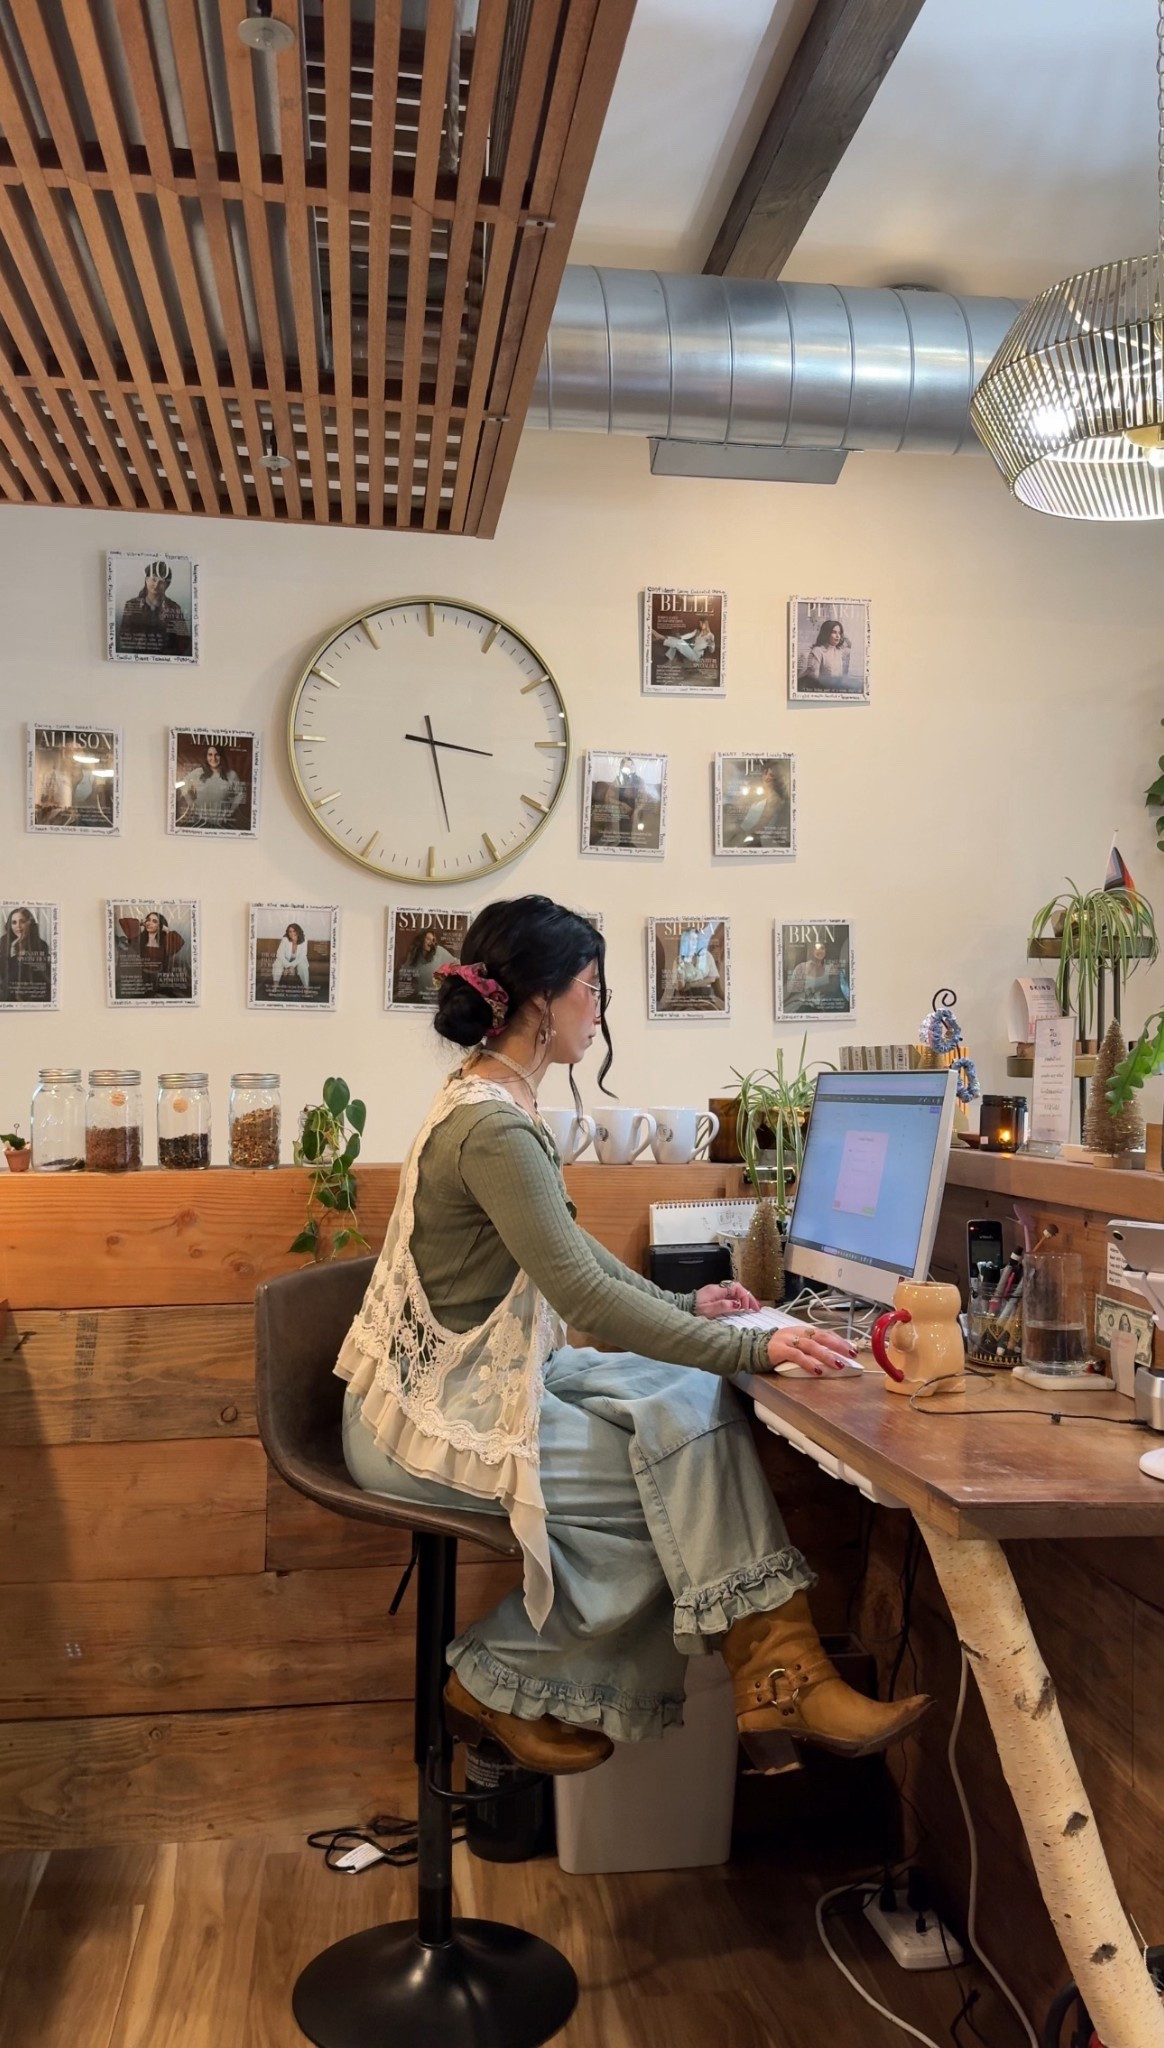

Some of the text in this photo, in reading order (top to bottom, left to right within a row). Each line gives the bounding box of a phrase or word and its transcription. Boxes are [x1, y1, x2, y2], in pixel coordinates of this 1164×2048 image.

[660, 595, 714, 613] BELLE
[41, 730, 112, 750] ALLISON
[398, 912, 463, 931] SYDNIE
[789, 925, 835, 943] BRYN
